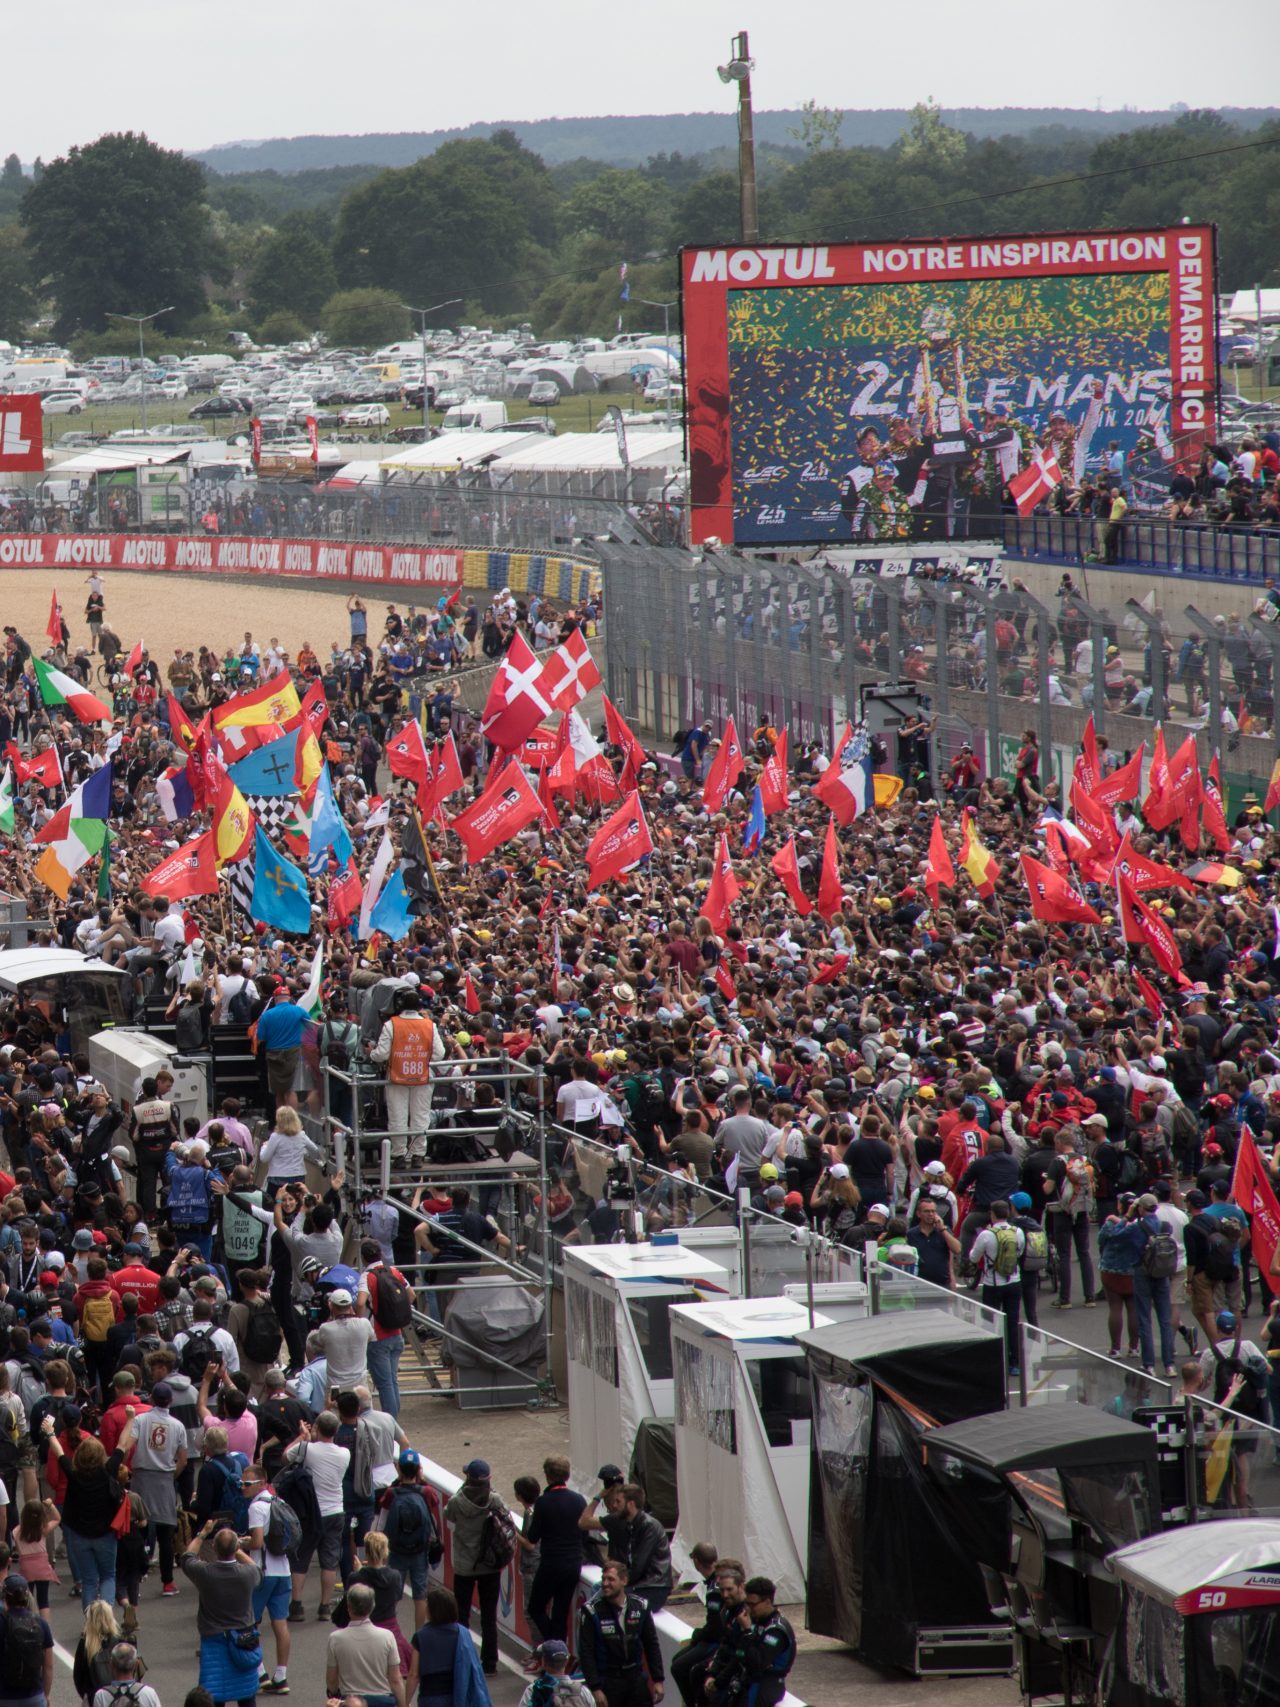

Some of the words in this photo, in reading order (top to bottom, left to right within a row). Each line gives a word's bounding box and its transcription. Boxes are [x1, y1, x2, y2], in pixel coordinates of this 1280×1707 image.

[690, 247, 835, 283] MOTUL
[863, 247, 964, 273] NOTRE
[971, 236, 1166, 268] INSPIRATION
[1178, 236, 1204, 383] DEMARRE
[728, 325, 783, 342] OLEX
[841, 319, 919, 338] ROLEX
[1025, 367, 1173, 408] MANS
[1079, 409, 1116, 428] JIN
[1180, 389, 1206, 430] ICI
[55, 539, 112, 563] MOTUL
[122, 540, 166, 565] MOTUL
[176, 541, 212, 566] MOTUL
[219, 542, 249, 568] MOTUL
[250, 543, 280, 570] MOTUL
[285, 544, 312, 571] MOTUL
[316, 546, 347, 575] MOTUL
[354, 550, 384, 578] MOTUL
[390, 552, 421, 581] MOTUL
[425, 553, 458, 582] MOTUL
[526, 742, 549, 750] GR
[402, 1061, 424, 1075] 688
[230, 1236, 255, 1250] 1049
[121, 1281, 157, 1289] REBELLION
[150, 1426, 167, 1446] 6
[1198, 1591, 1227, 1609] 50
